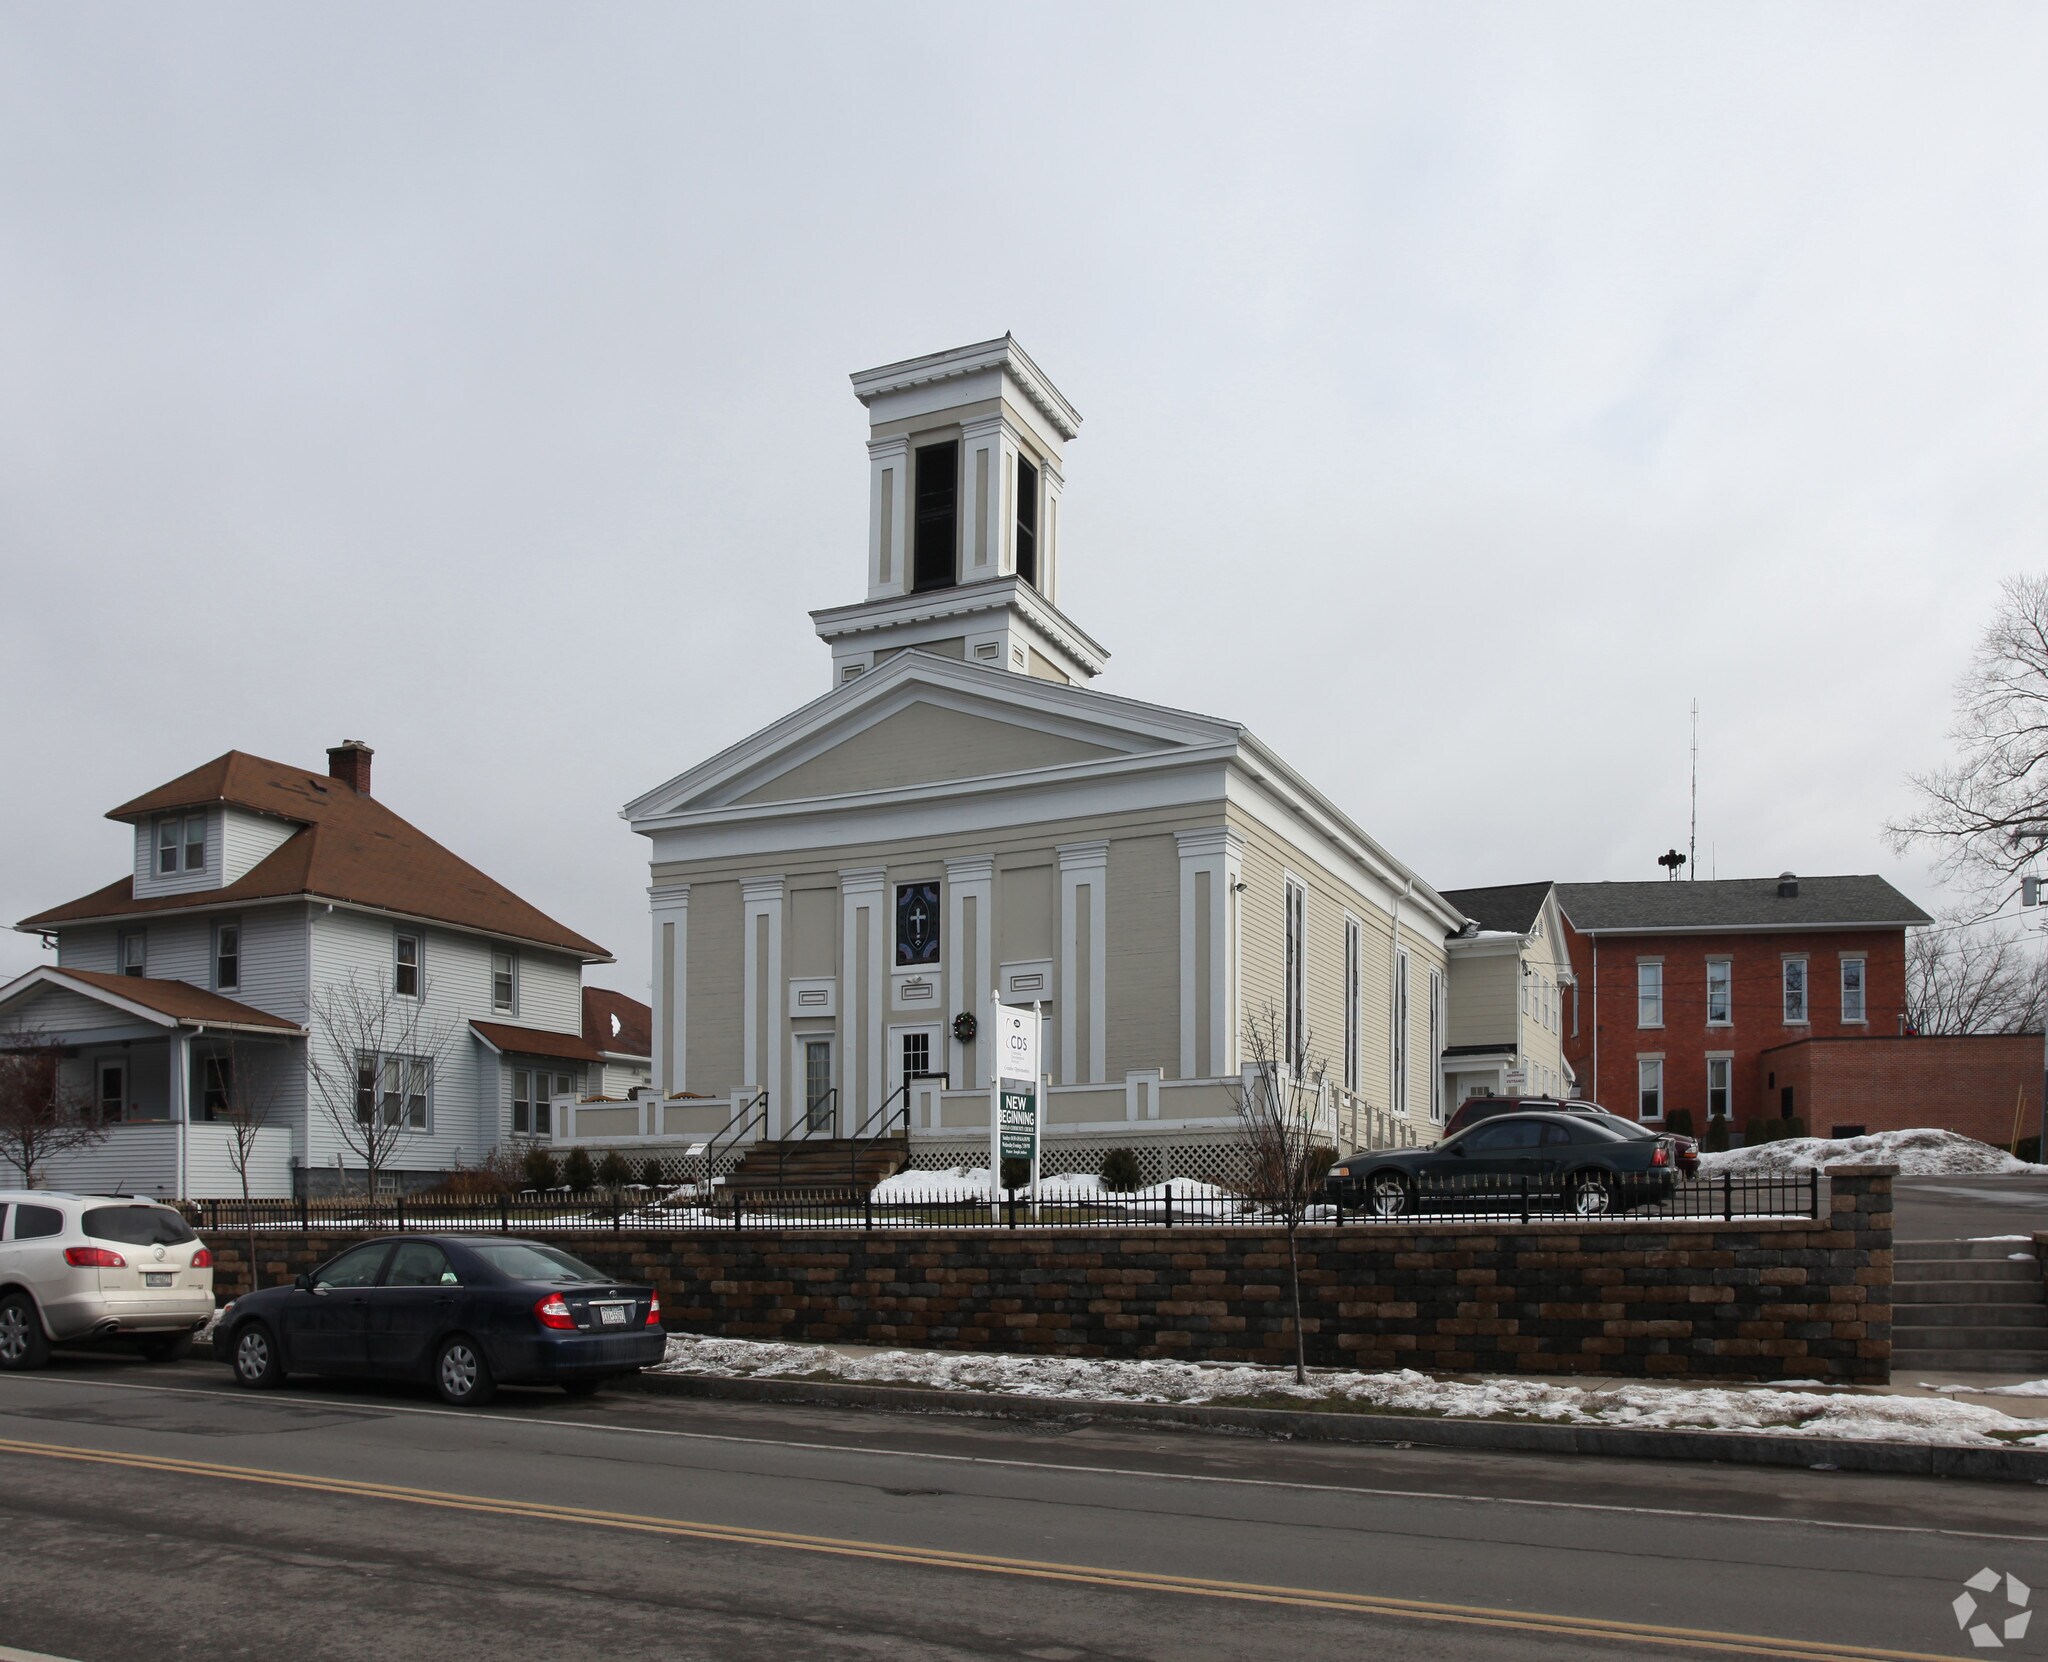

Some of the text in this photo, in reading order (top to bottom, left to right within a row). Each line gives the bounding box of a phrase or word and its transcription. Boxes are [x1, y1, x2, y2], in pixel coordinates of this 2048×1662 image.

[1011, 1035, 1028, 1051] CDS
[1006, 1095, 1026, 1110] NEW
[999, 1110, 1034, 1126] BEGINNING
